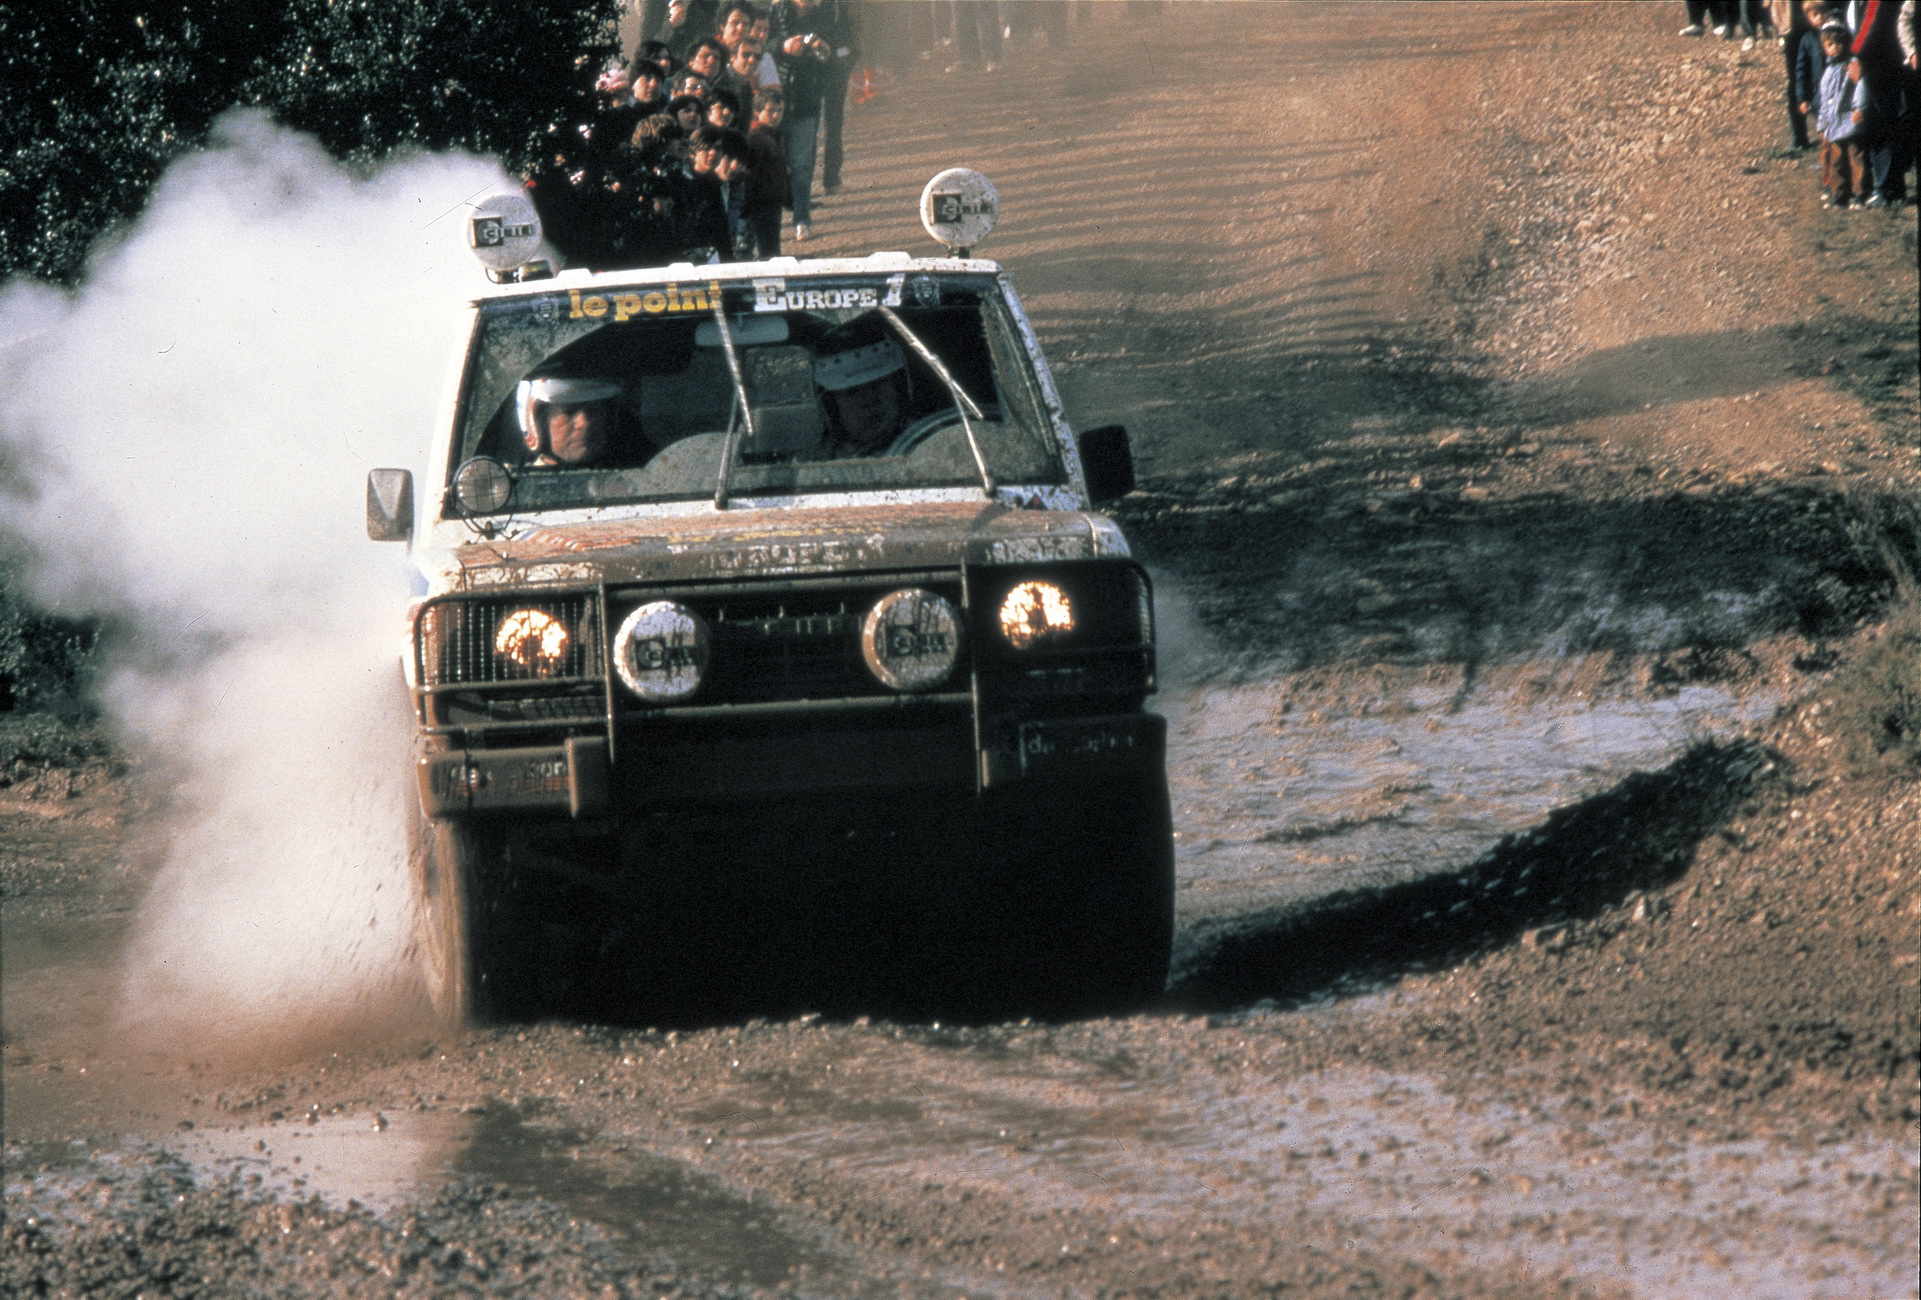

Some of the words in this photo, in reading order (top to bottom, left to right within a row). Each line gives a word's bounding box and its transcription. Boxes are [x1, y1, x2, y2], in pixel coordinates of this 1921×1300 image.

[569, 288, 608, 319] le
[613, 280, 723, 322] point
[882, 273, 906, 307] 1
